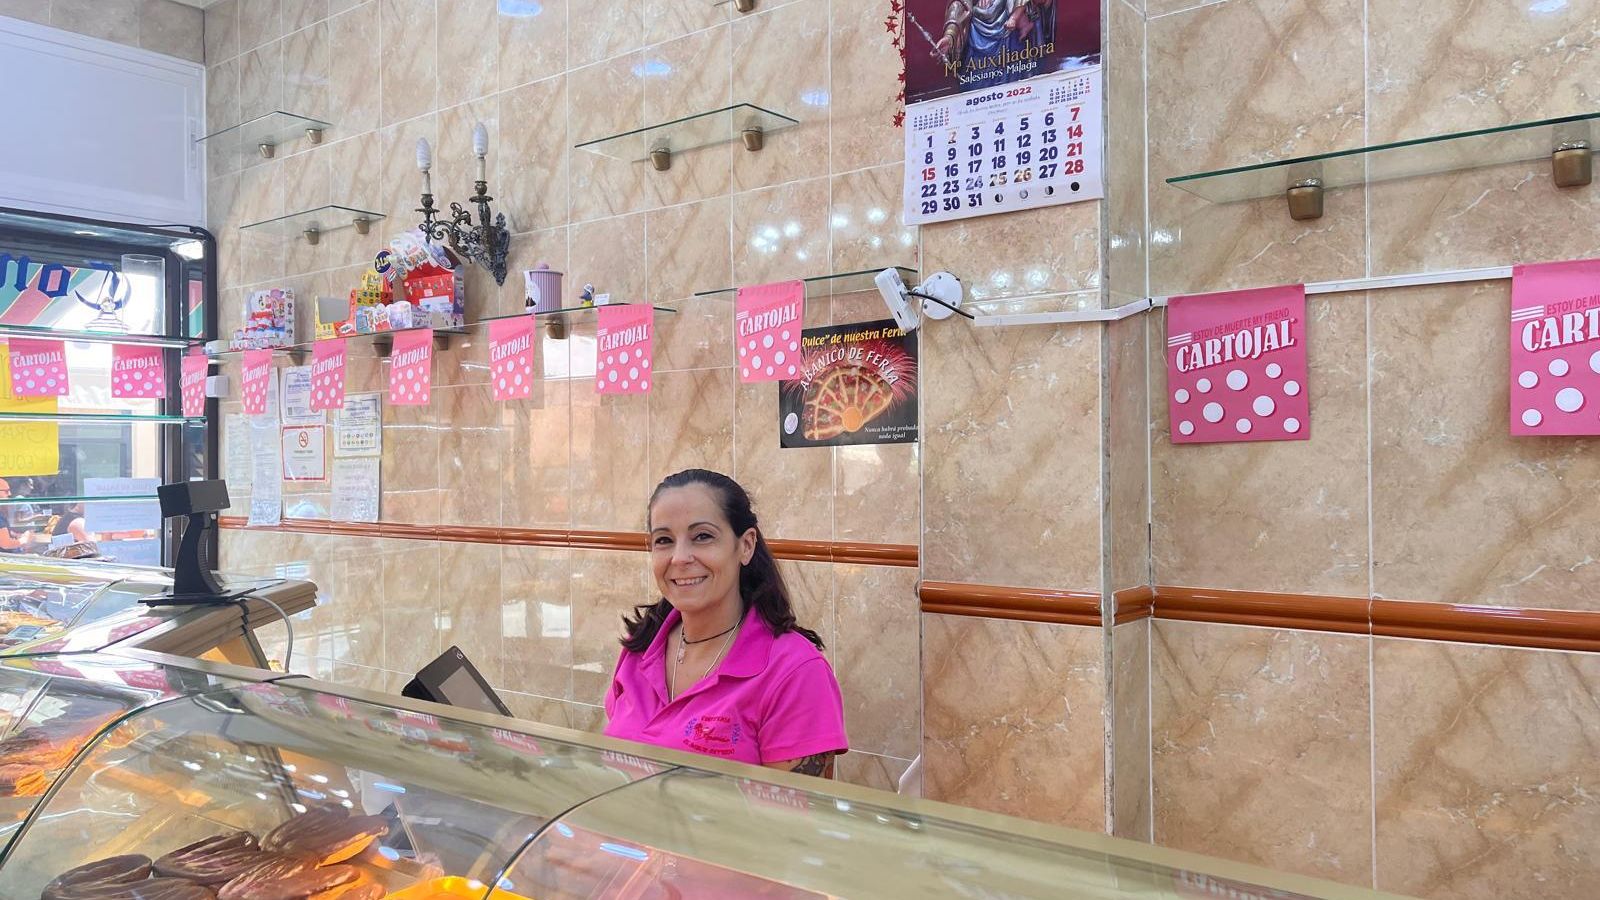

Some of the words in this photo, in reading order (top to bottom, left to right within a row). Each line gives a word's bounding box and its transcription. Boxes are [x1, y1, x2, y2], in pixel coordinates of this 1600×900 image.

[966, 40, 1055, 72] Auxiliadora
[960, 69, 1003, 84] Salesianos
[1006, 60, 1037, 74] Málaga
[966, 91, 1004, 106] agosto
[1006, 86, 1032, 98] 2022
[927, 135, 933, 148] 1
[948, 132, 956, 144] 2
[972, 127, 980, 140] 3
[995, 122, 1004, 135] 4
[1020, 118, 1029, 131] 5
[1045, 113, 1054, 126] 6
[1071, 107, 1080, 121] 7
[925, 152, 933, 164] 8
[948, 148, 956, 160] 9
[968, 143, 982, 156] 10
[994, 139, 1005, 152] 11
[1017, 134, 1031, 148] 12
[1042, 130, 1056, 143] 13
[1067, 124, 1083, 139] 14
[922, 168, 935, 181] 15
[945, 164, 958, 177] 16
[968, 160, 982, 173] 17
[992, 156, 1006, 169] 18
[1016, 151, 1031, 165] 19
[1039, 147, 1058, 162] 20
[1067, 143, 1082, 157] 21
[922, 184, 937, 197] 22
[943, 180, 959, 194] 23
[966, 176, 983, 190] 24
[990, 172, 1007, 186] 25
[1014, 168, 1032, 182] 26
[1039, 164, 1057, 178] 27
[1065, 160, 1083, 175] 28
[922, 201, 938, 214] 29
[943, 197, 960, 211] 30
[968, 193, 982, 207] 31
[740, 303, 798, 337] CARTOJAL
[1547, 299, 1574, 316] ESTOY
[1576, 296, 1588, 309] DE
[831, 334, 842, 344] de
[844, 330, 880, 343] nuestra
[1194, 327, 1214, 340] ESTOY
[1215, 325, 1224, 335] DE
[1225, 318, 1252, 333] MUERTE
[1253, 314, 1263, 325] MY
[1265, 307, 1290, 321] FRIEND
[1522, 307, 1600, 352] CART
[491, 335, 531, 363] CARTOJAL
[600, 324, 649, 352] CARTOJAL
[1176, 318, 1294, 373] CARTOJAL
[14, 352, 63, 368] CARTOJAL
[114, 356, 160, 371] CARTOJAL
[313, 354, 344, 376] CARTOJAL
[392, 346, 429, 369] CARTOJAL
[800, 348, 845, 391] ABANICO
[848, 347, 864, 360] DE
[866, 351, 900, 385] FERIA
[243, 363, 269, 384] CARTOJAL
